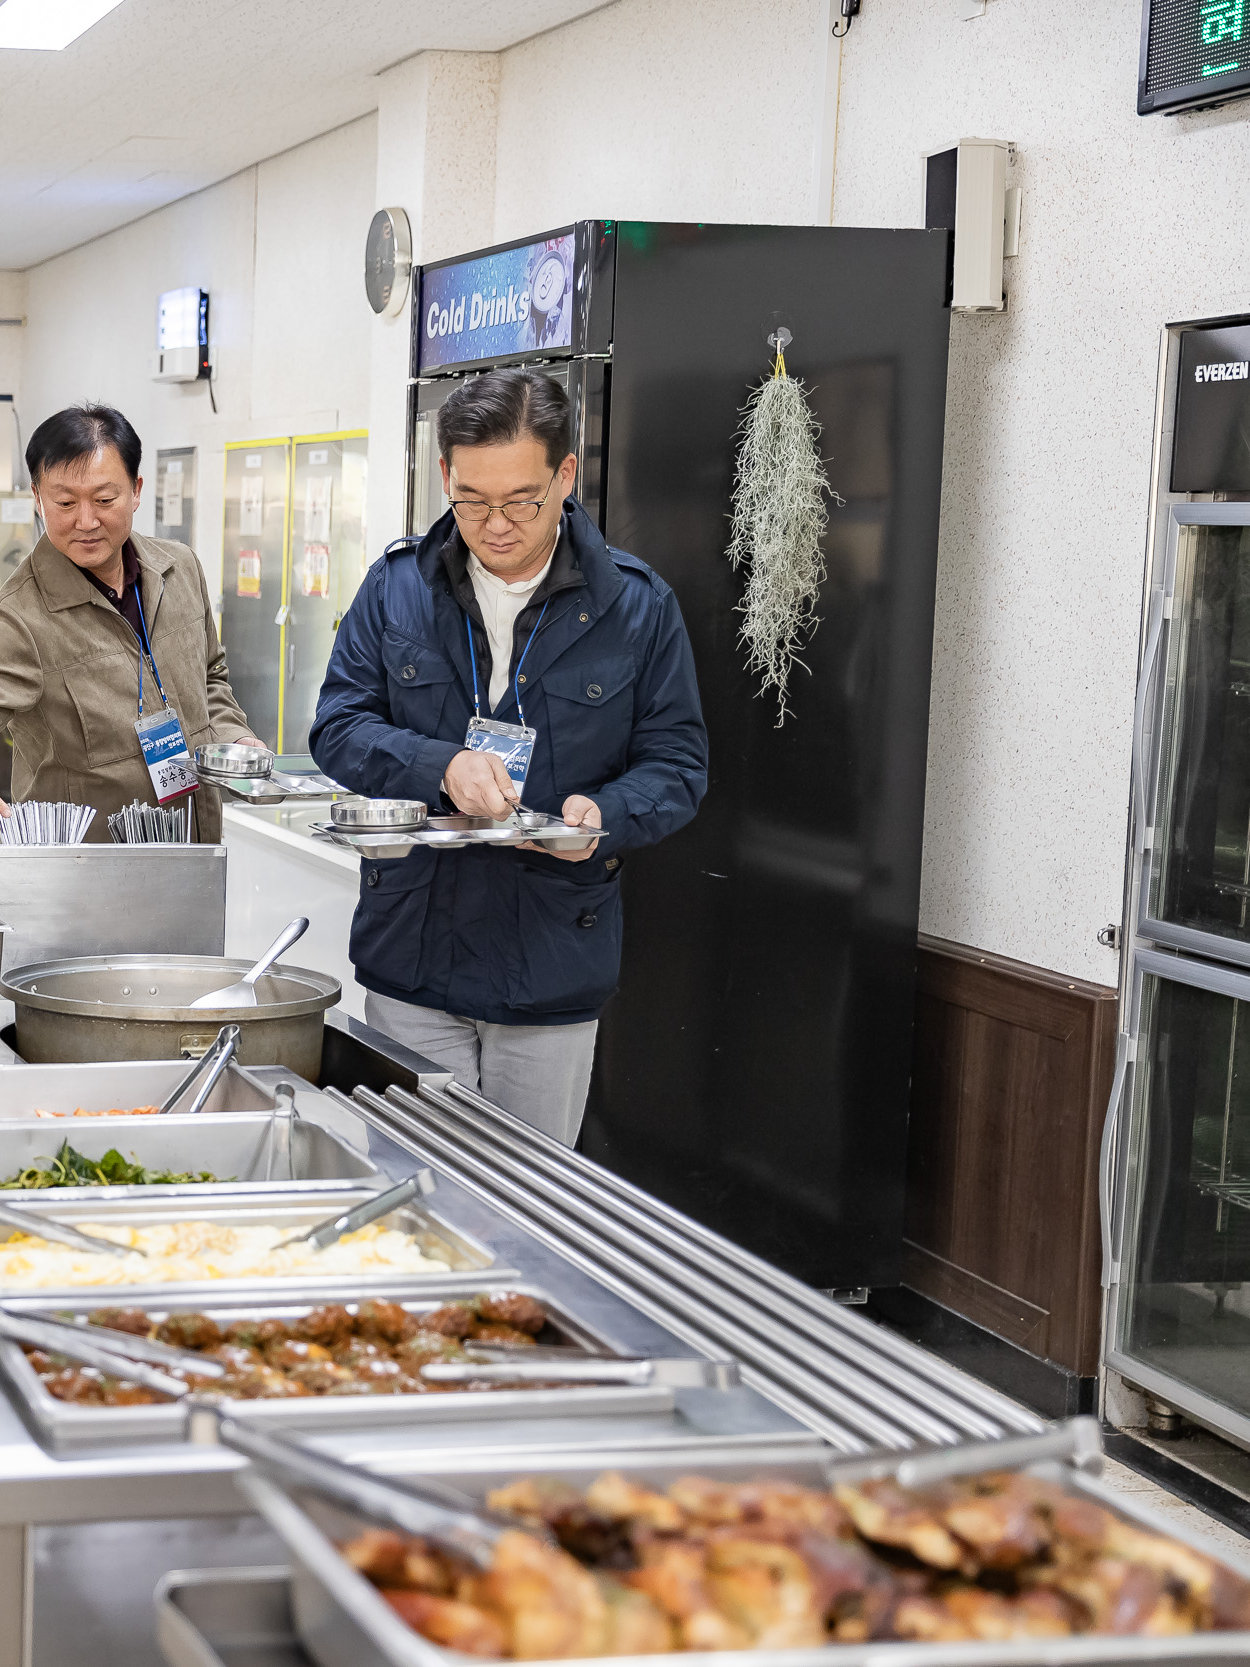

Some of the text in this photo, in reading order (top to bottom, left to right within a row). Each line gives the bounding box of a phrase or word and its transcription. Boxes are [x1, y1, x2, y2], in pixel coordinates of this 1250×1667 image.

[427, 285, 530, 339] Cold Drinks
[1195, 361, 1249, 383] EVERZEN
